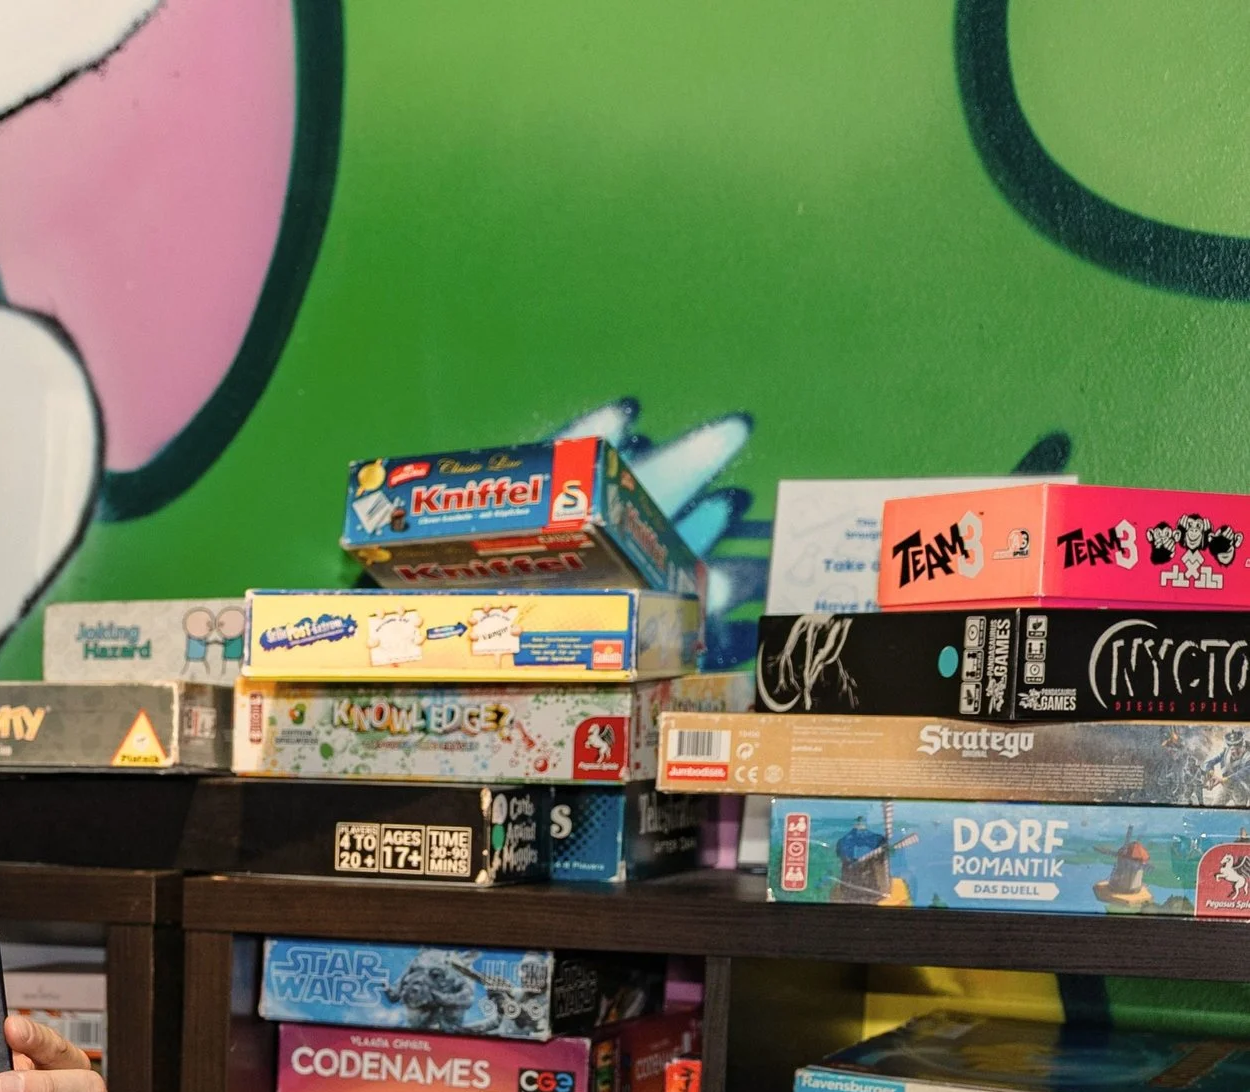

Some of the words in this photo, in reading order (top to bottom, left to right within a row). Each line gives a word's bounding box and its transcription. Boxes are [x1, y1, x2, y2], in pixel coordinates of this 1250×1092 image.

[411, 474, 543, 516] Kniffel
[394, 552, 587, 584] Kniffel
[823, 558, 867, 574] Take
[83, 640, 152, 660] Hazard
[995, 617, 1011, 684] GAMES
[1039, 696, 1077, 711] GAMES
[1115, 701, 1176, 713] DIESES
[1190, 702, 1239, 713] SPIEL
[917, 725, 1035, 758] Stratego
[339, 835, 350, 849] 4
[353, 835, 377, 849] TO
[383, 829, 421, 847] AGES
[429, 829, 468, 847] TIME
[953, 818, 1068, 854] DORF
[383, 848, 422, 868] 17+
[429, 846, 469, 858] 30-90
[429, 857, 468, 873] MINS
[952, 855, 1063, 878] ROMANTIK
[973, 884, 998, 895] DAS
[1001, 885, 1040, 896] DUELL
[1205, 899, 1235, 910] Pegasus
[272, 945, 390, 980] STAR
[272, 974, 390, 1006] WARS
[290, 1046, 491, 1090] CODENAMES
